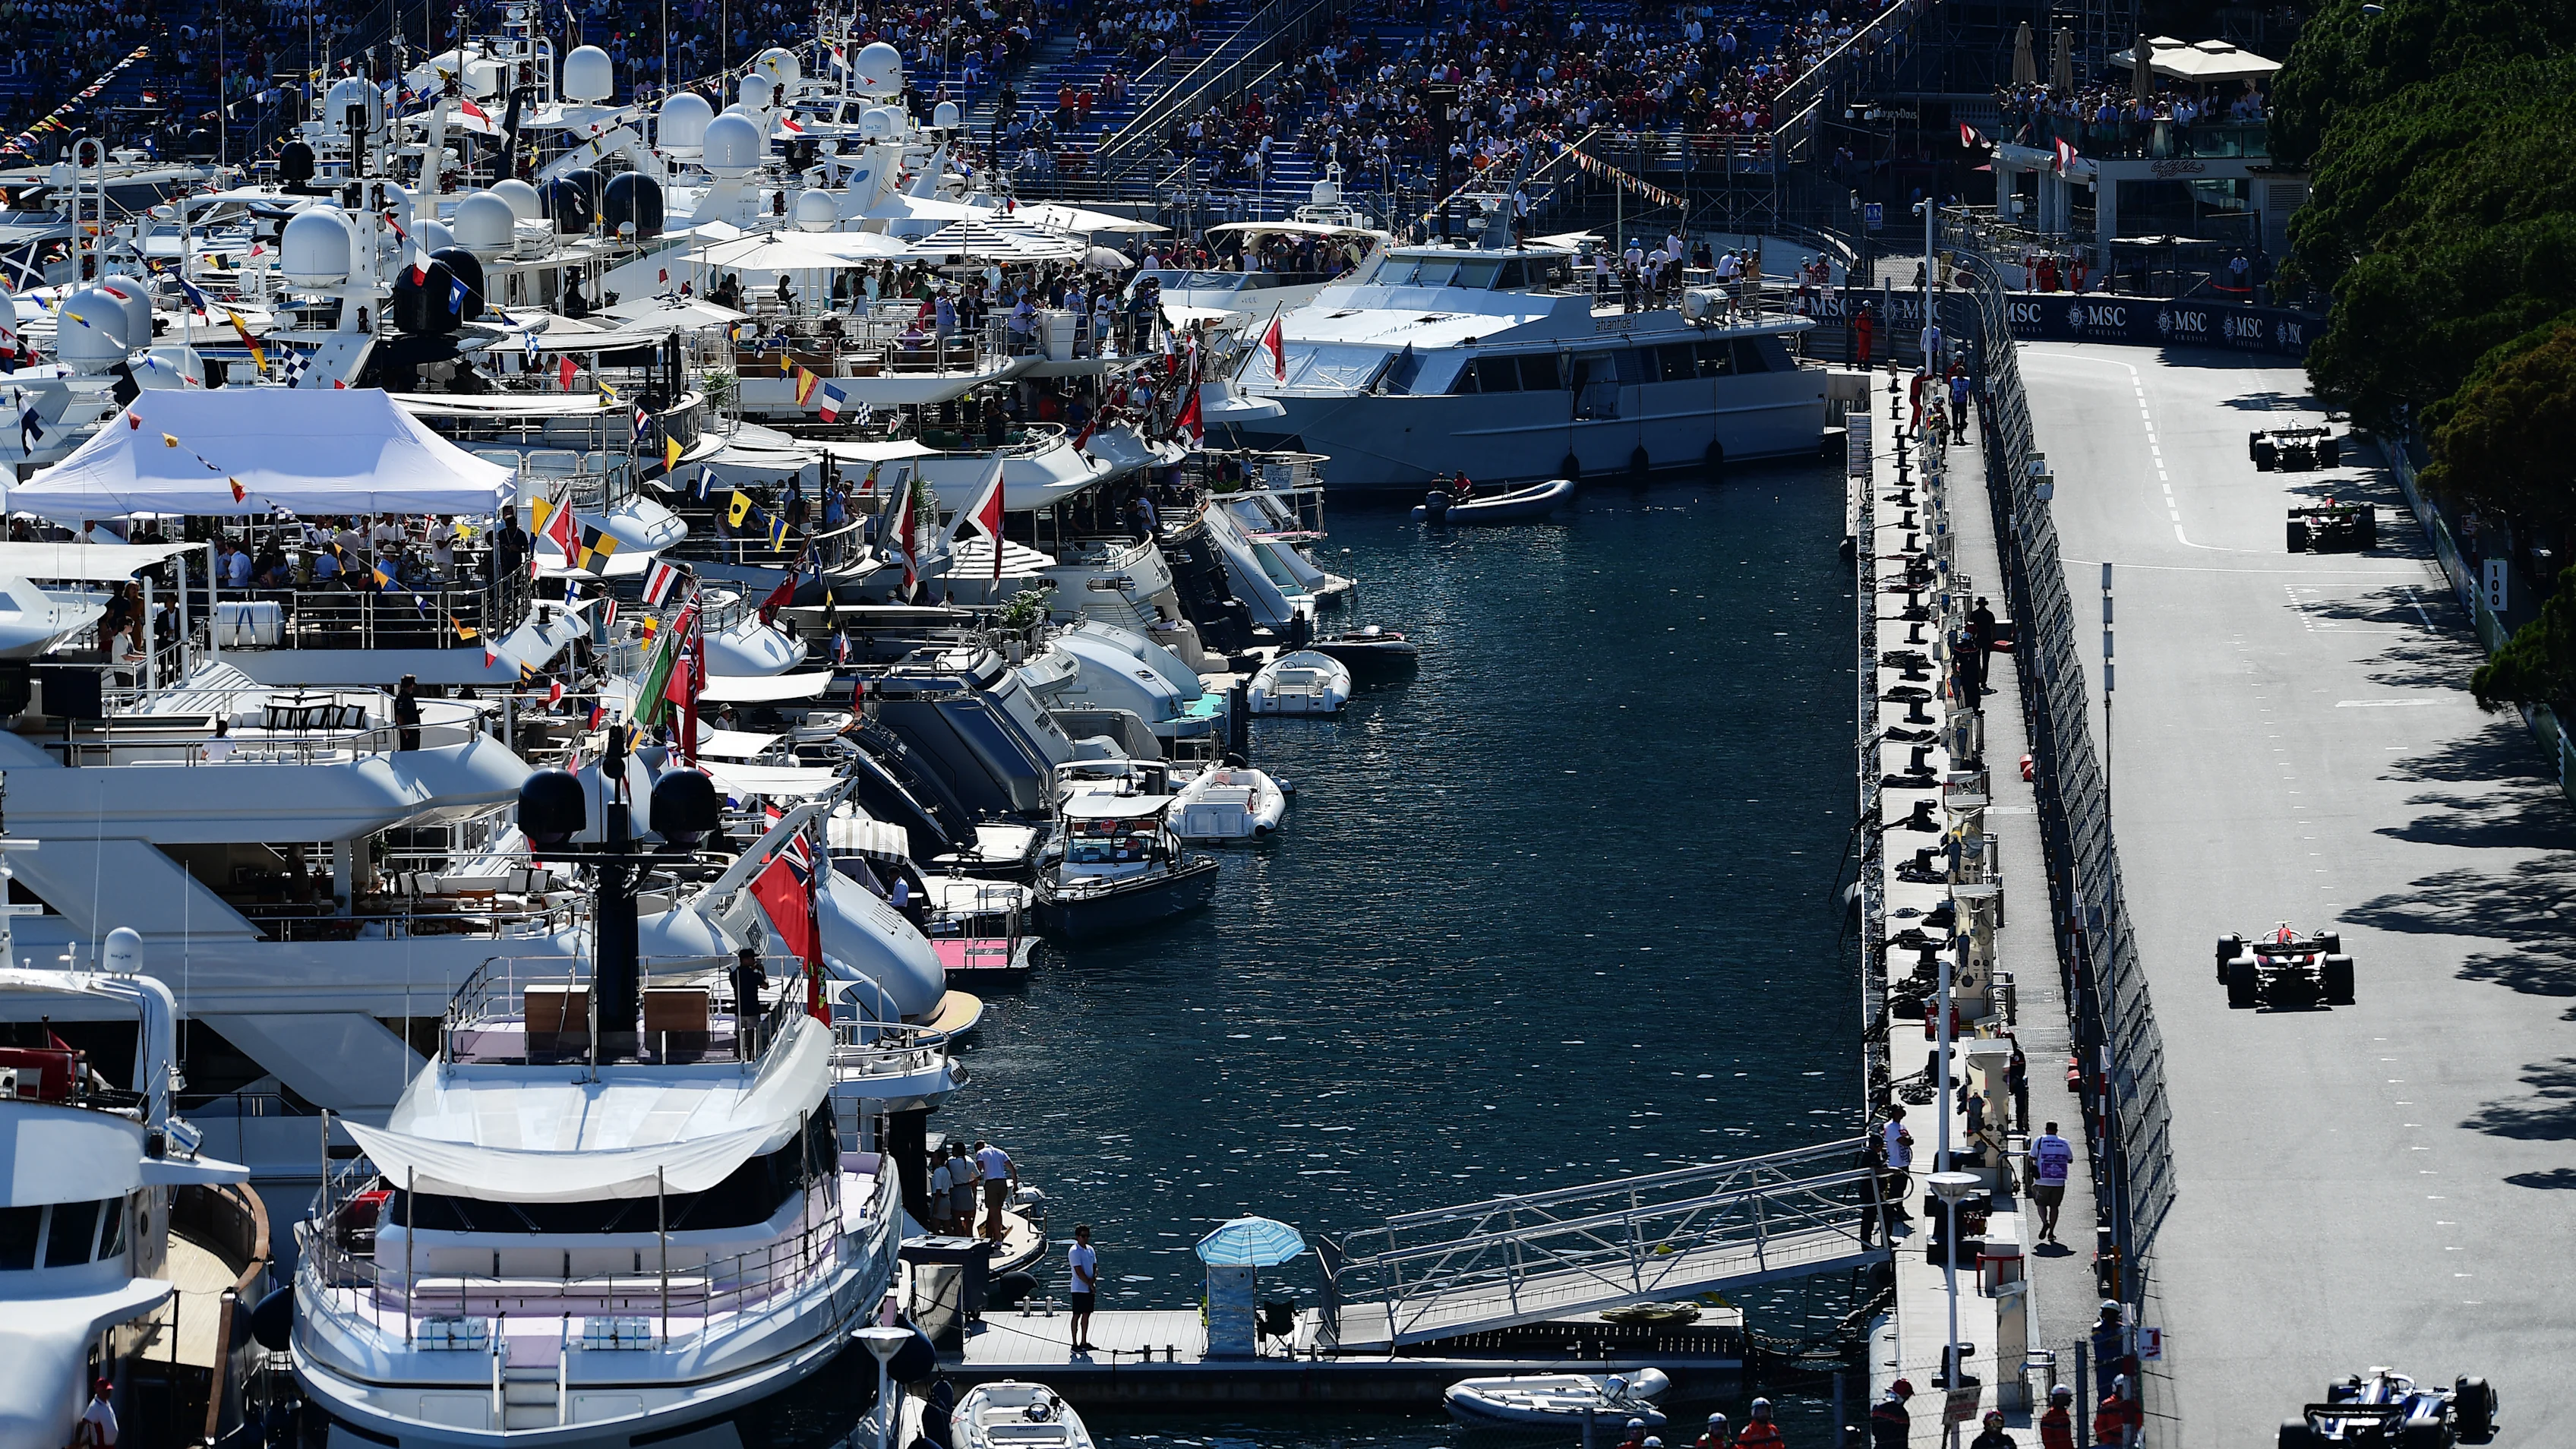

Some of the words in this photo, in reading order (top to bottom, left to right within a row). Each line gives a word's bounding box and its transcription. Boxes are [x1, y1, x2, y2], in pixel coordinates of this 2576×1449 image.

[1596, 317, 1631, 332] atlantide
[1634, 316, 1637, 327] 1
[2088, 305, 2126, 327] MSC
[2174, 311, 2208, 333] MSC
[2236, 316, 2263, 339] MSC
[2287, 322, 2303, 345] MSC
[2491, 565, 2500, 606] 100
[2261, 942, 2321, 951] ORACLE
